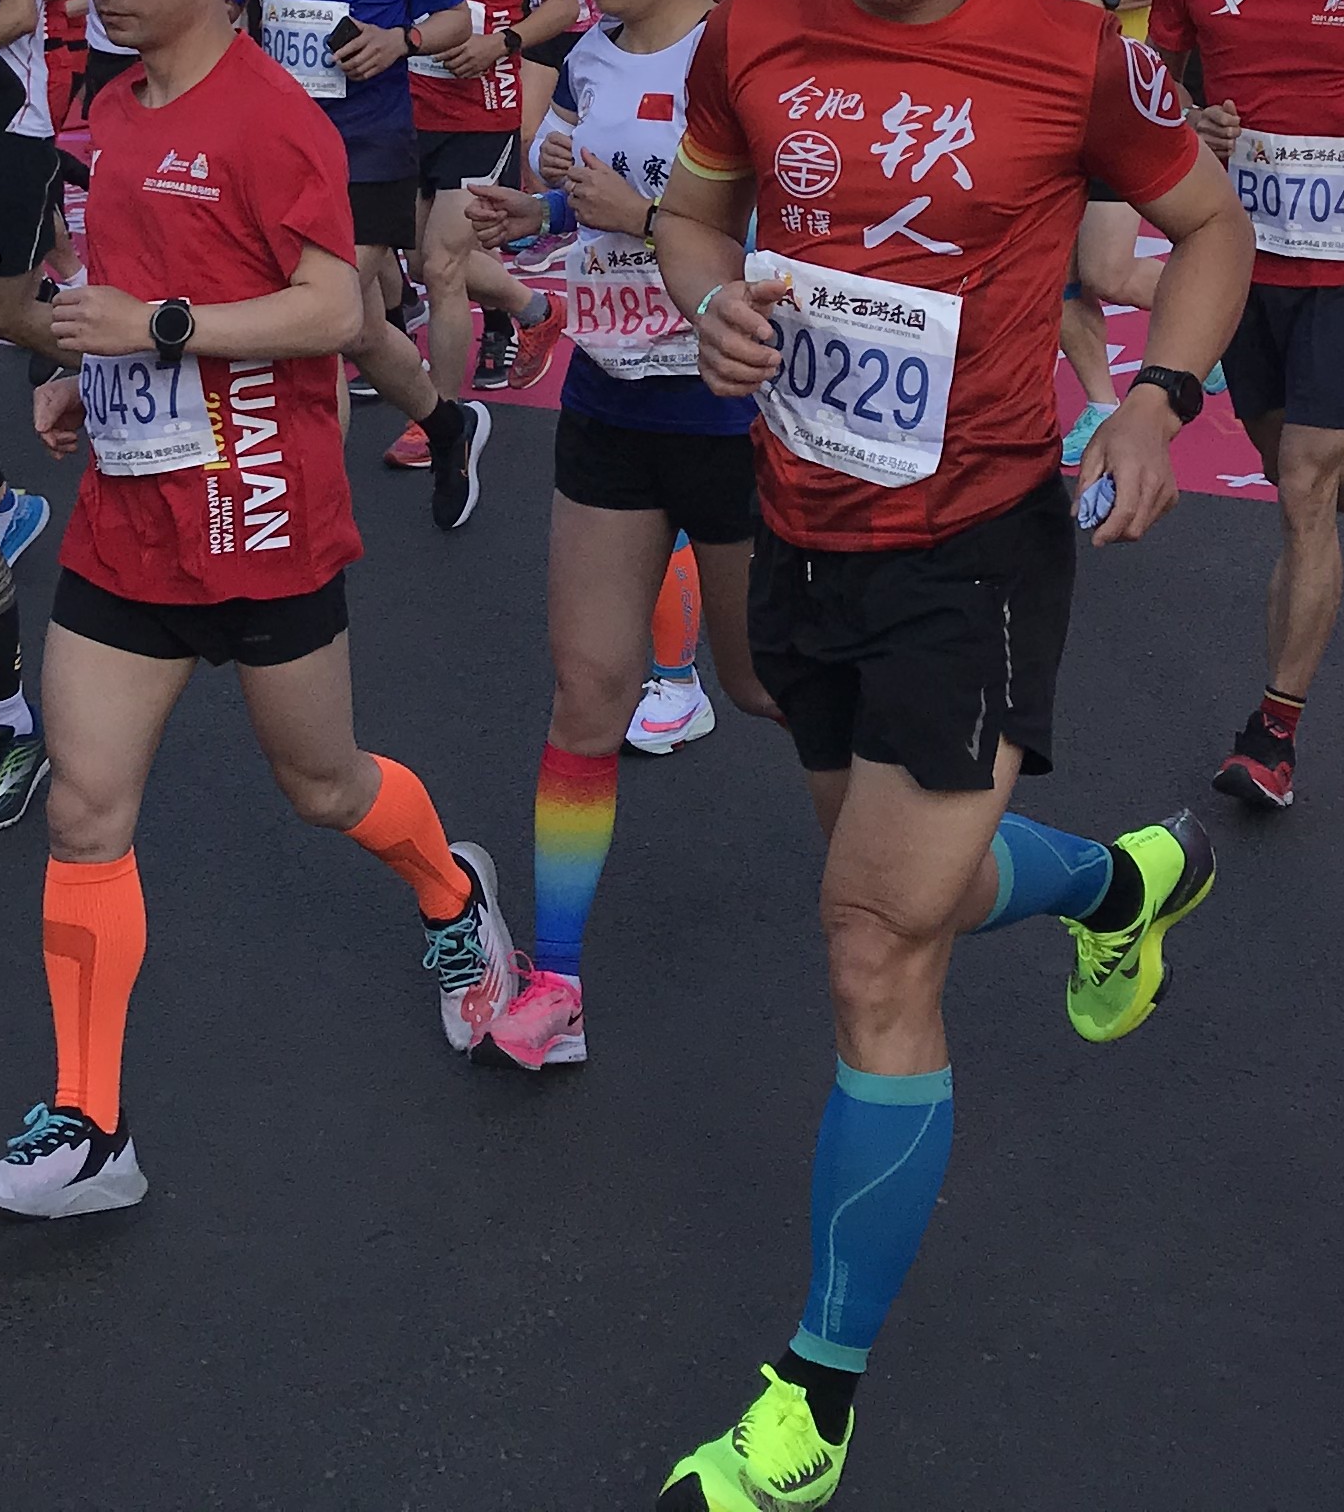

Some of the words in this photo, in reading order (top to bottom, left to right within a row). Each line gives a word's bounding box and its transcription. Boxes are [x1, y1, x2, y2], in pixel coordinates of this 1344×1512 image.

[778, 76, 866, 121] 合肥
[863, 91, 976, 257] 铁人
[780, 204, 832, 238] 逍遥
[809, 286, 927, 332] 淮安西游乐园
[793, 425, 815, 441] 2021
[866, 451, 919, 474] 淮安马拉松
[206, 475, 222, 555] MARATHON
[221, 496, 235, 553] HUAI'AN
